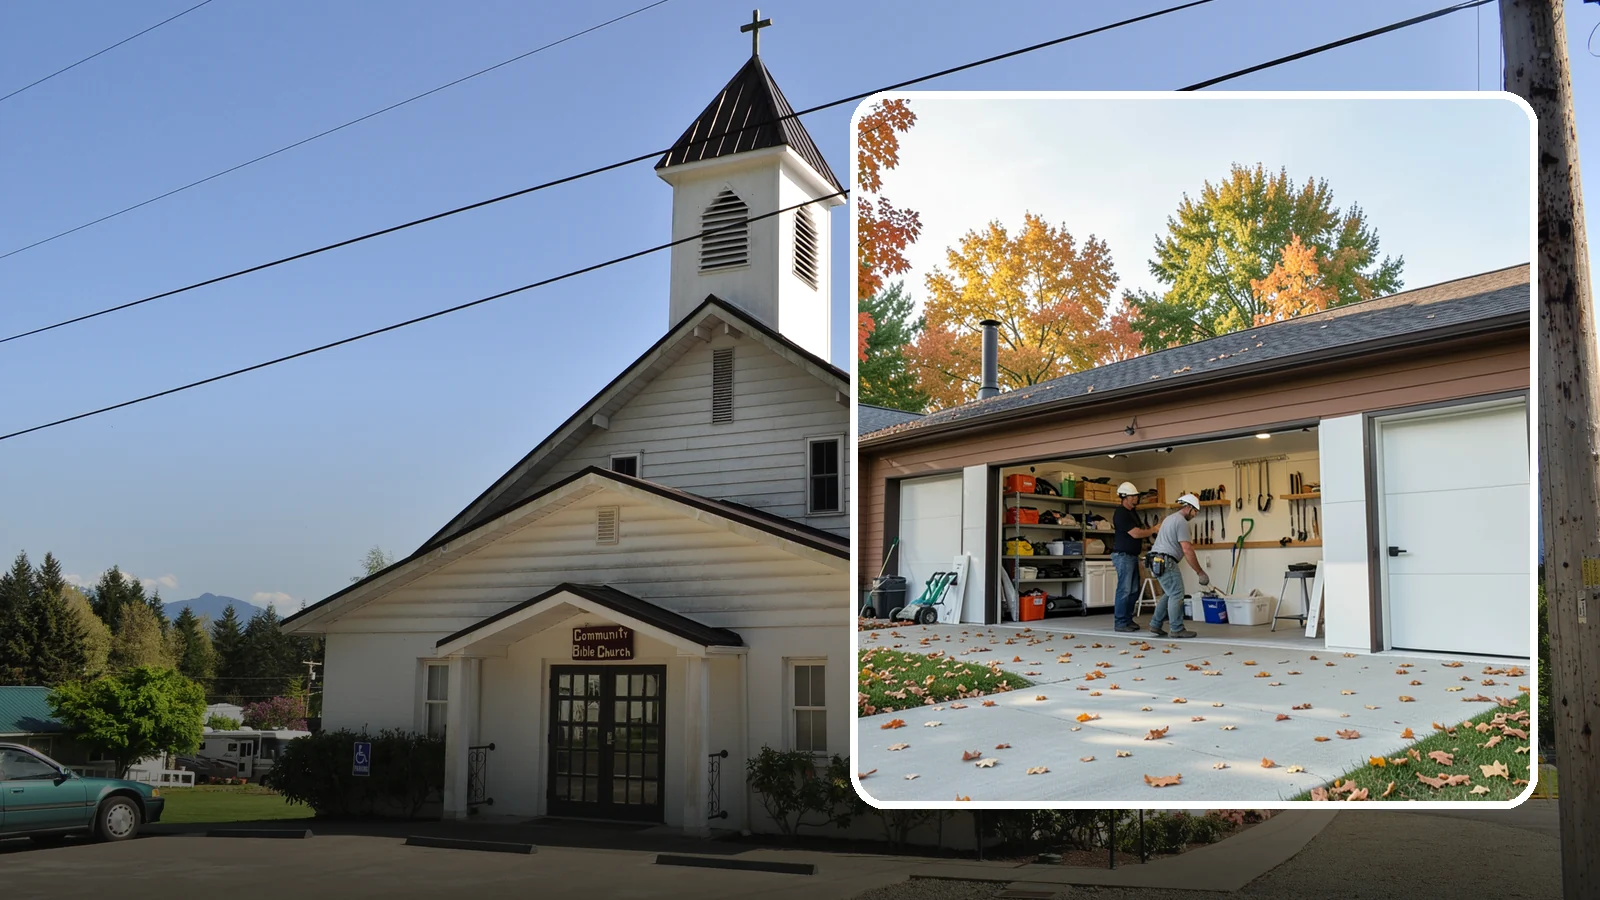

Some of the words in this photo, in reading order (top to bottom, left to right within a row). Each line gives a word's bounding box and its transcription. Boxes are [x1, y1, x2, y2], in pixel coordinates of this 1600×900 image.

[574, 627, 629, 642] Community
[571, 644, 595, 657] Bible
[597, 645, 631, 658] Church
